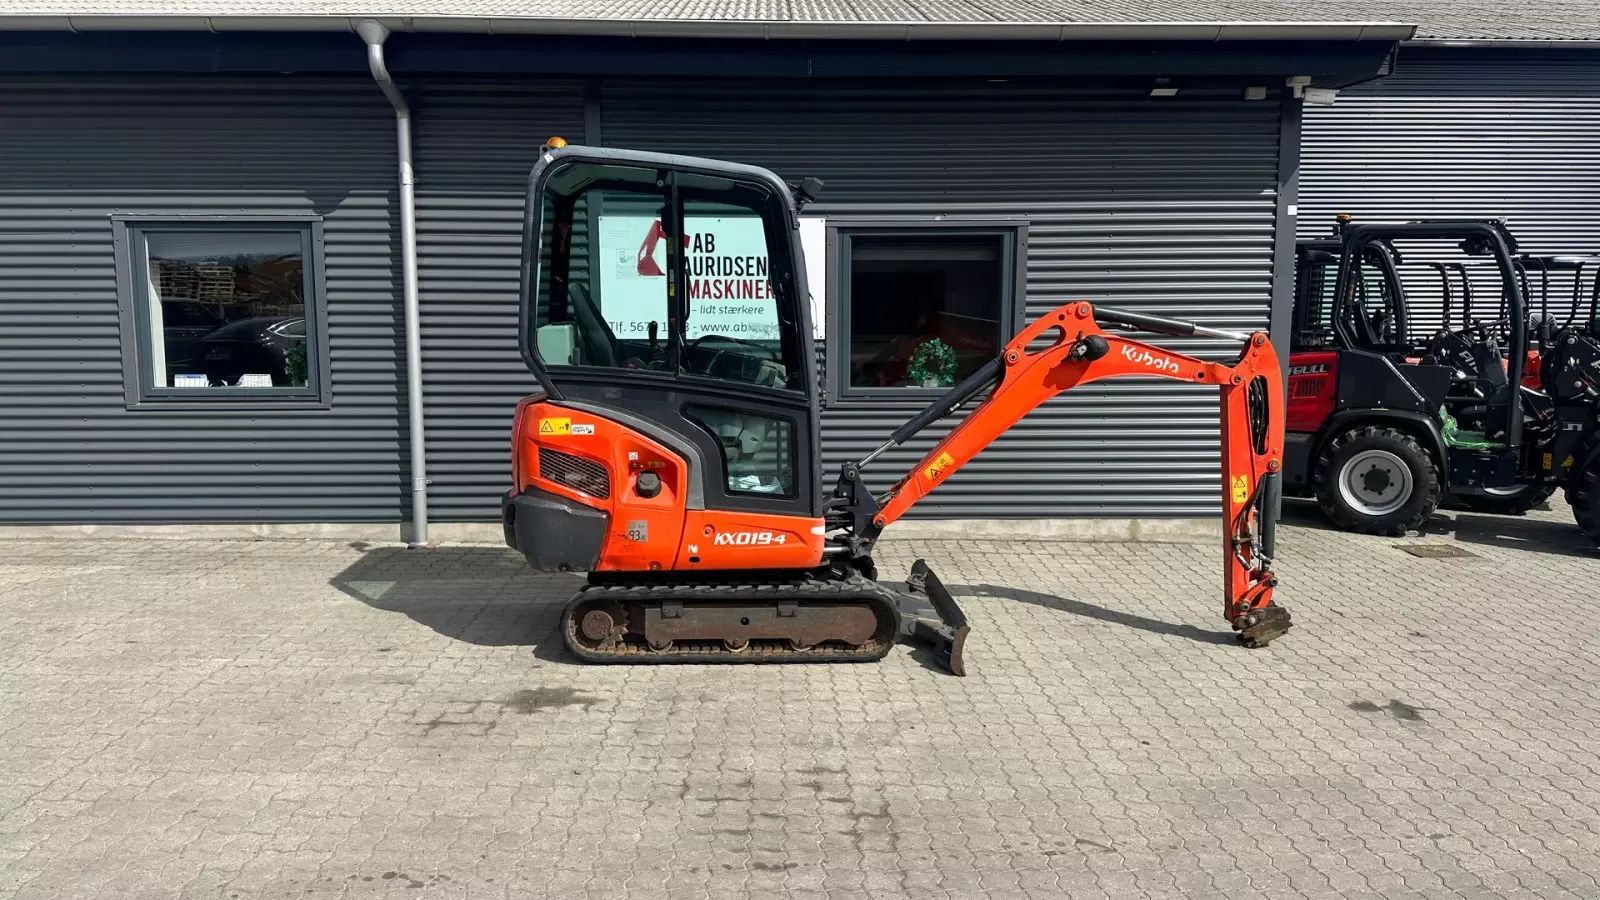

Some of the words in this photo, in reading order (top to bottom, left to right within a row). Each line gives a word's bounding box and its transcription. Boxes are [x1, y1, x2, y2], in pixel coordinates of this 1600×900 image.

[693, 233, 715, 253] AB
[684, 256, 767, 276] AURIDSEN
[700, 304, 716, 315] lidt
[718, 305, 764, 315] stærkere
[1121, 344, 1180, 373] Kubota
